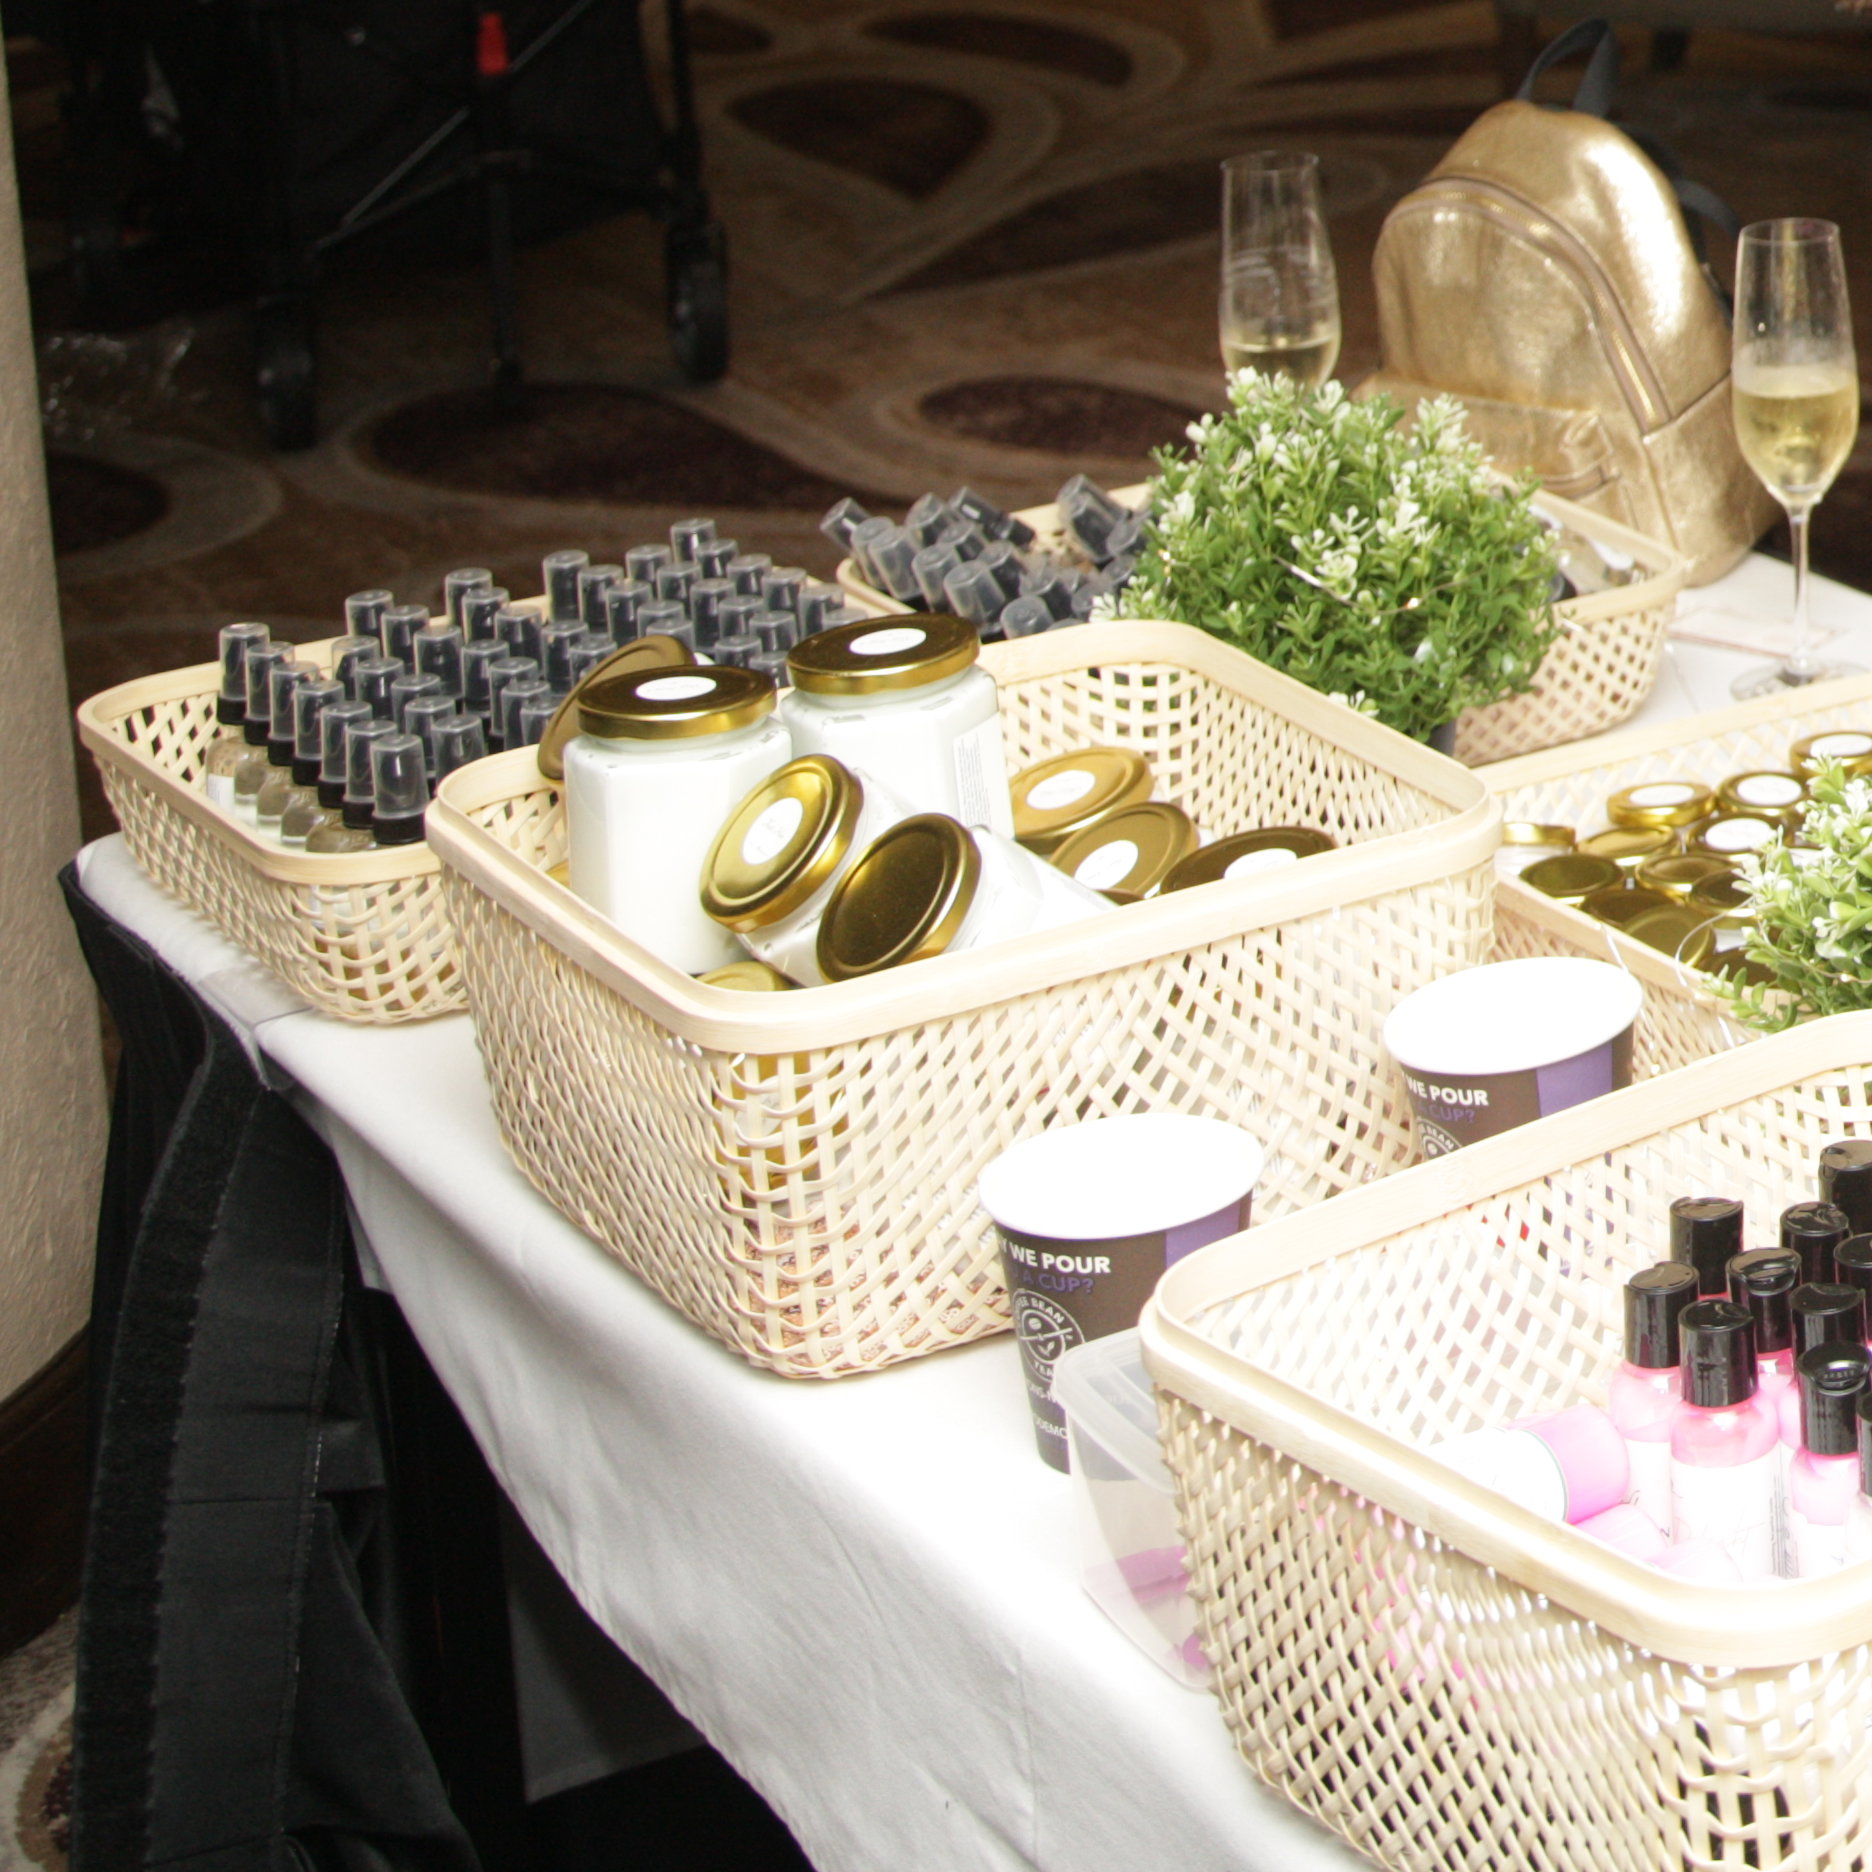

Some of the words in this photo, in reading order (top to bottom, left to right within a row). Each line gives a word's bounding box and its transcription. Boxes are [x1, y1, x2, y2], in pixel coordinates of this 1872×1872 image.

[1429, 1085, 1489, 1107] POUR
[1429, 1105, 1475, 1124] CUP?
[1009, 1241, 1038, 1267] WE
[1041, 1252, 1111, 1274] POUR
[1039, 1274, 1094, 1293] CUP?
[1031, 1297, 1065, 1324] BEAN
